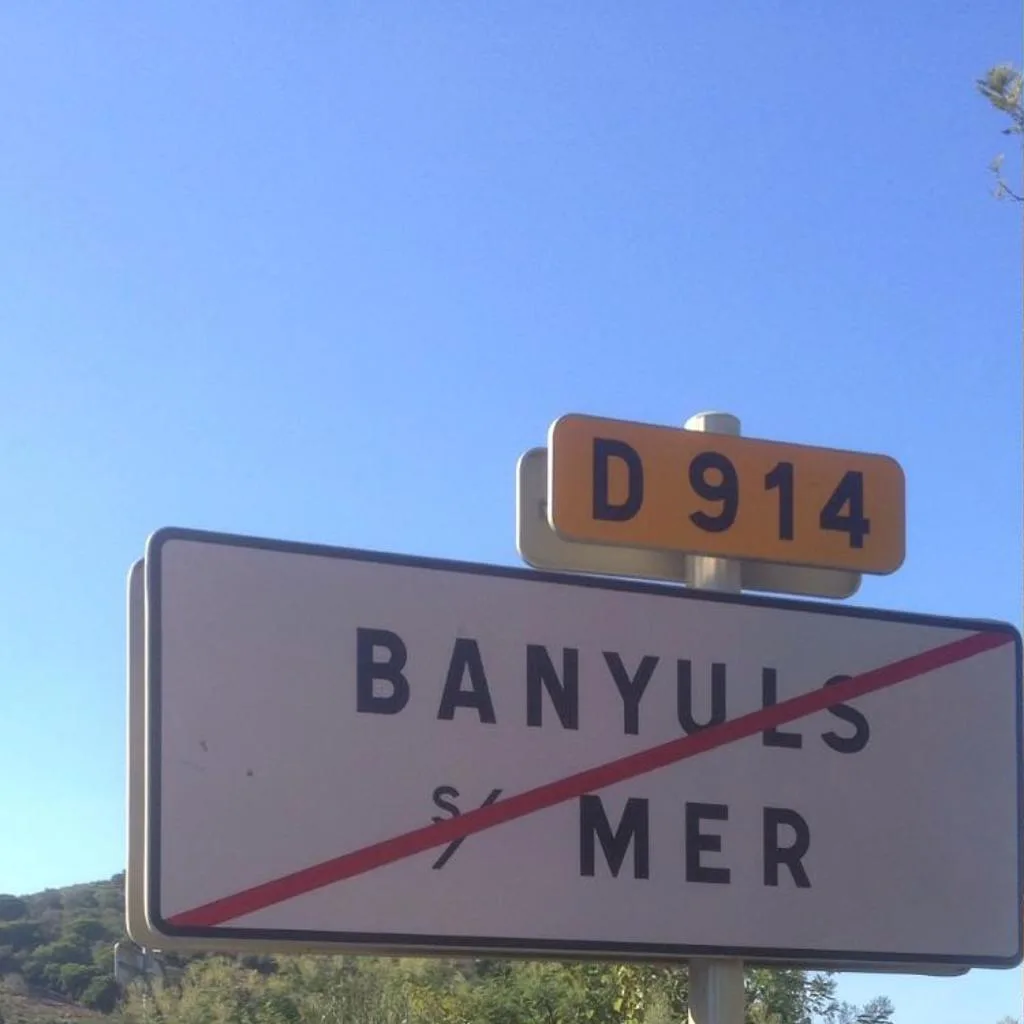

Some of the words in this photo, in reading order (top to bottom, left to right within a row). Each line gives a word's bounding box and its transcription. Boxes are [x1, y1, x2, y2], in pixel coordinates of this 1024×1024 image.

[592, 437, 645, 522] D
[688, 451, 871, 549] 914
[356, 627, 870, 754] BANYULS
[579, 795, 811, 888] MER
